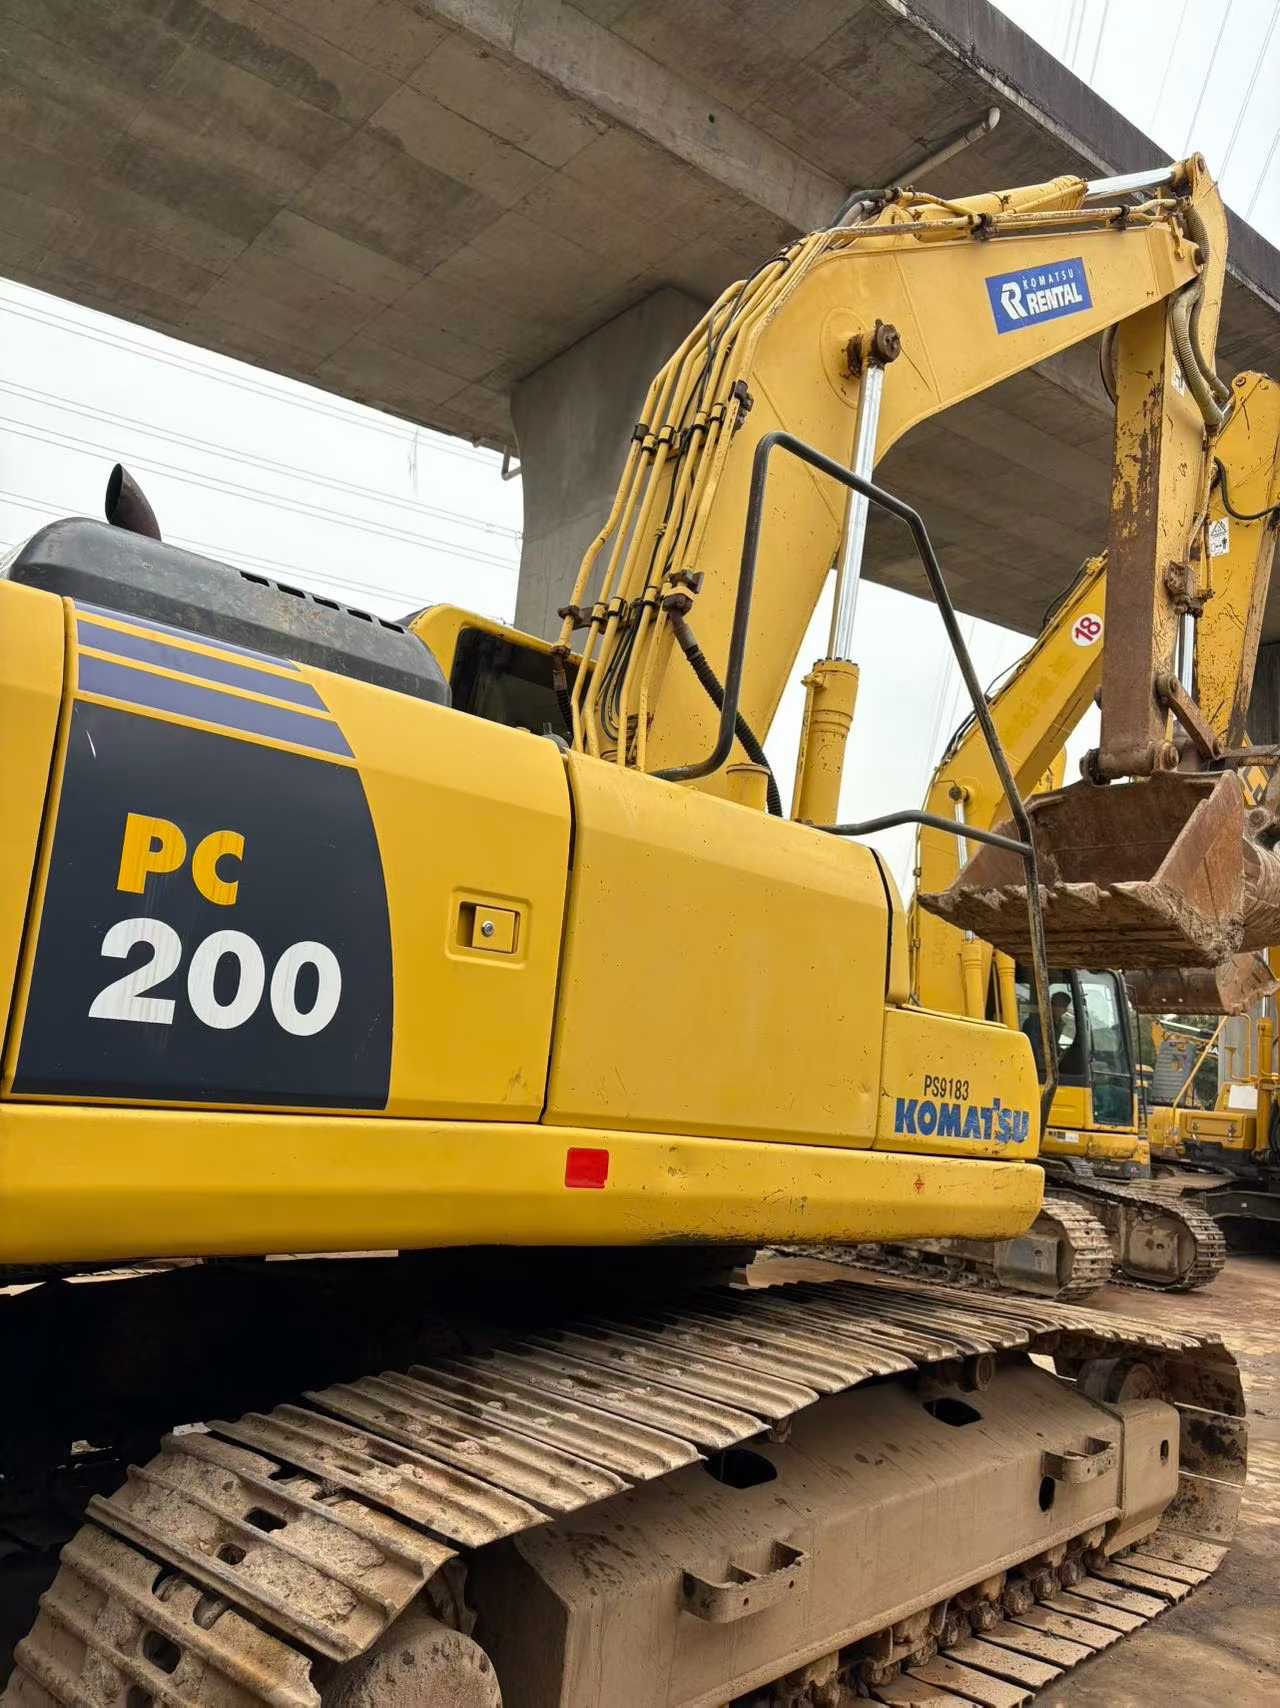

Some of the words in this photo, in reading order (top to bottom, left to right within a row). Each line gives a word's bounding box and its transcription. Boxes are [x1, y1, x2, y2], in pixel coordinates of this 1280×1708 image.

[1022, 268, 1074, 290] KOMATSU
[1025, 282, 1083, 315] RENTAL
[1075, 617, 1101, 641] 18
[117, 812, 245, 905] PC
[88, 917, 342, 1037] 200
[924, 1074, 969, 1101] PS9183
[894, 1097, 1030, 1143] KOMATSU
